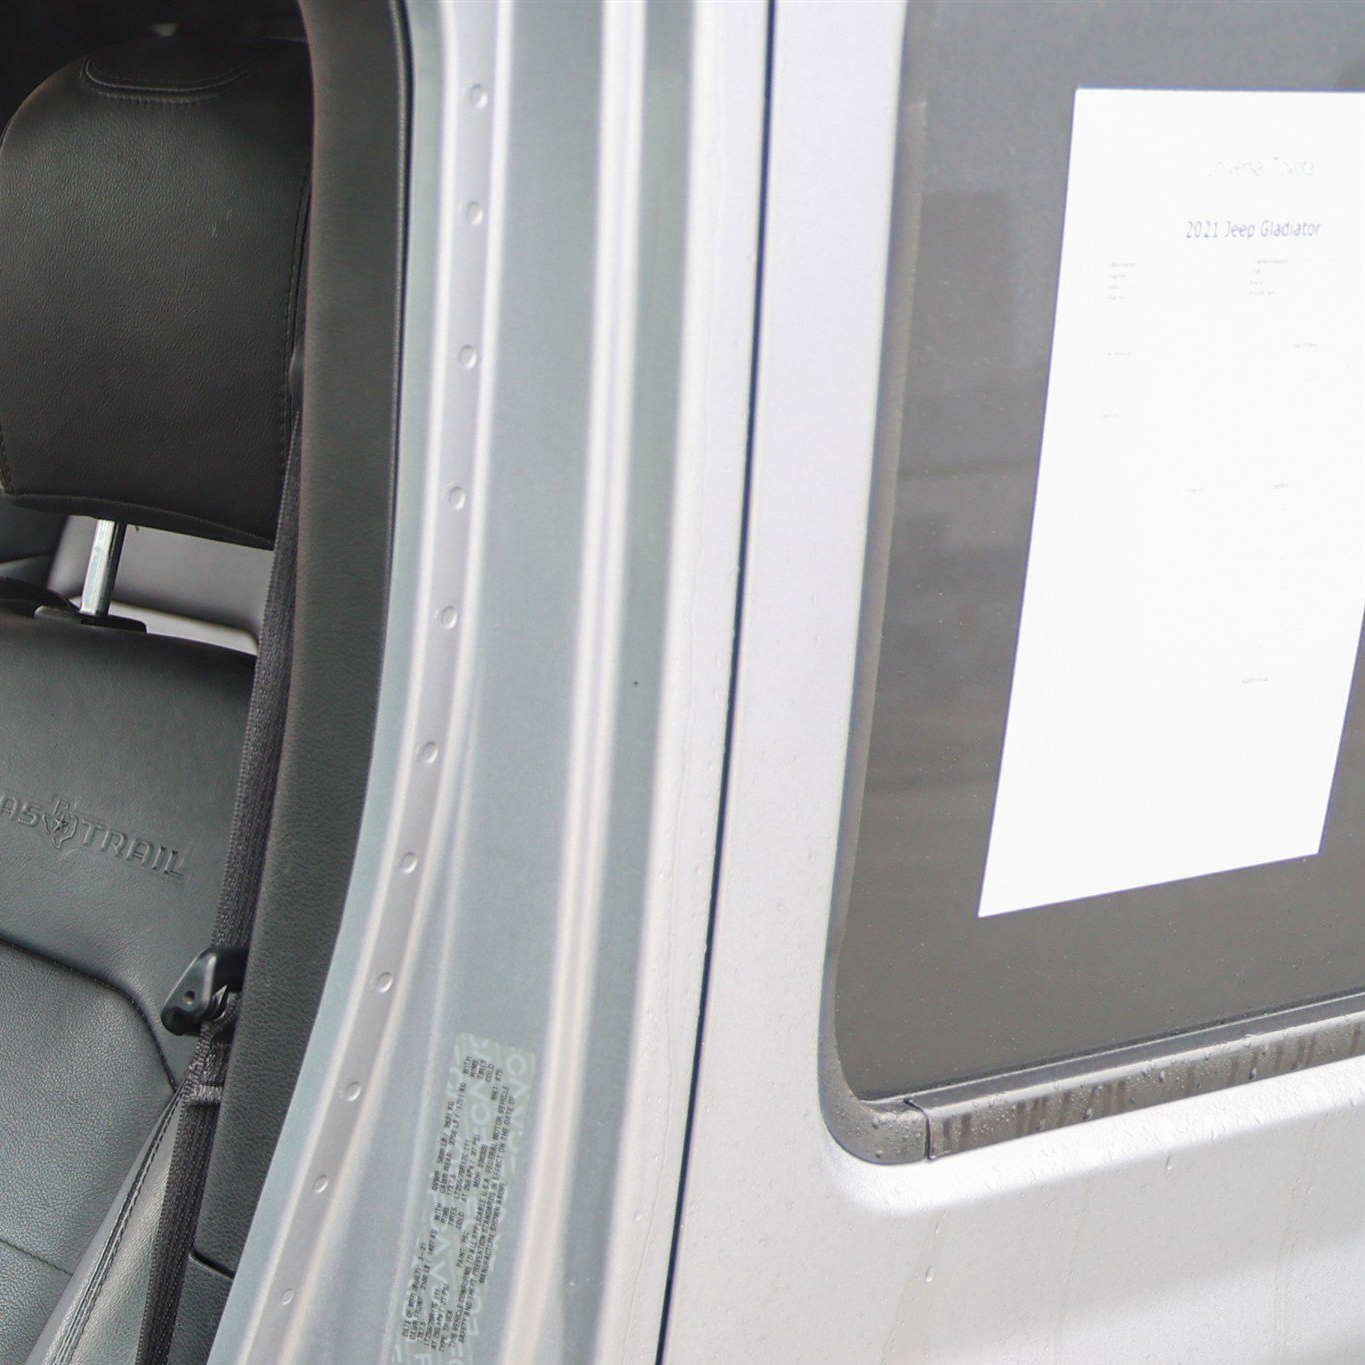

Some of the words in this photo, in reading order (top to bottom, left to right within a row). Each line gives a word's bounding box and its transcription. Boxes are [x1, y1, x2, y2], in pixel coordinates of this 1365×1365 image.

[1185, 220, 1219, 239] 2021
[1224, 220, 1255, 240] Jeep
[1260, 219, 1321, 238] Gladiator
[81, 818, 184, 881] TRAIL
